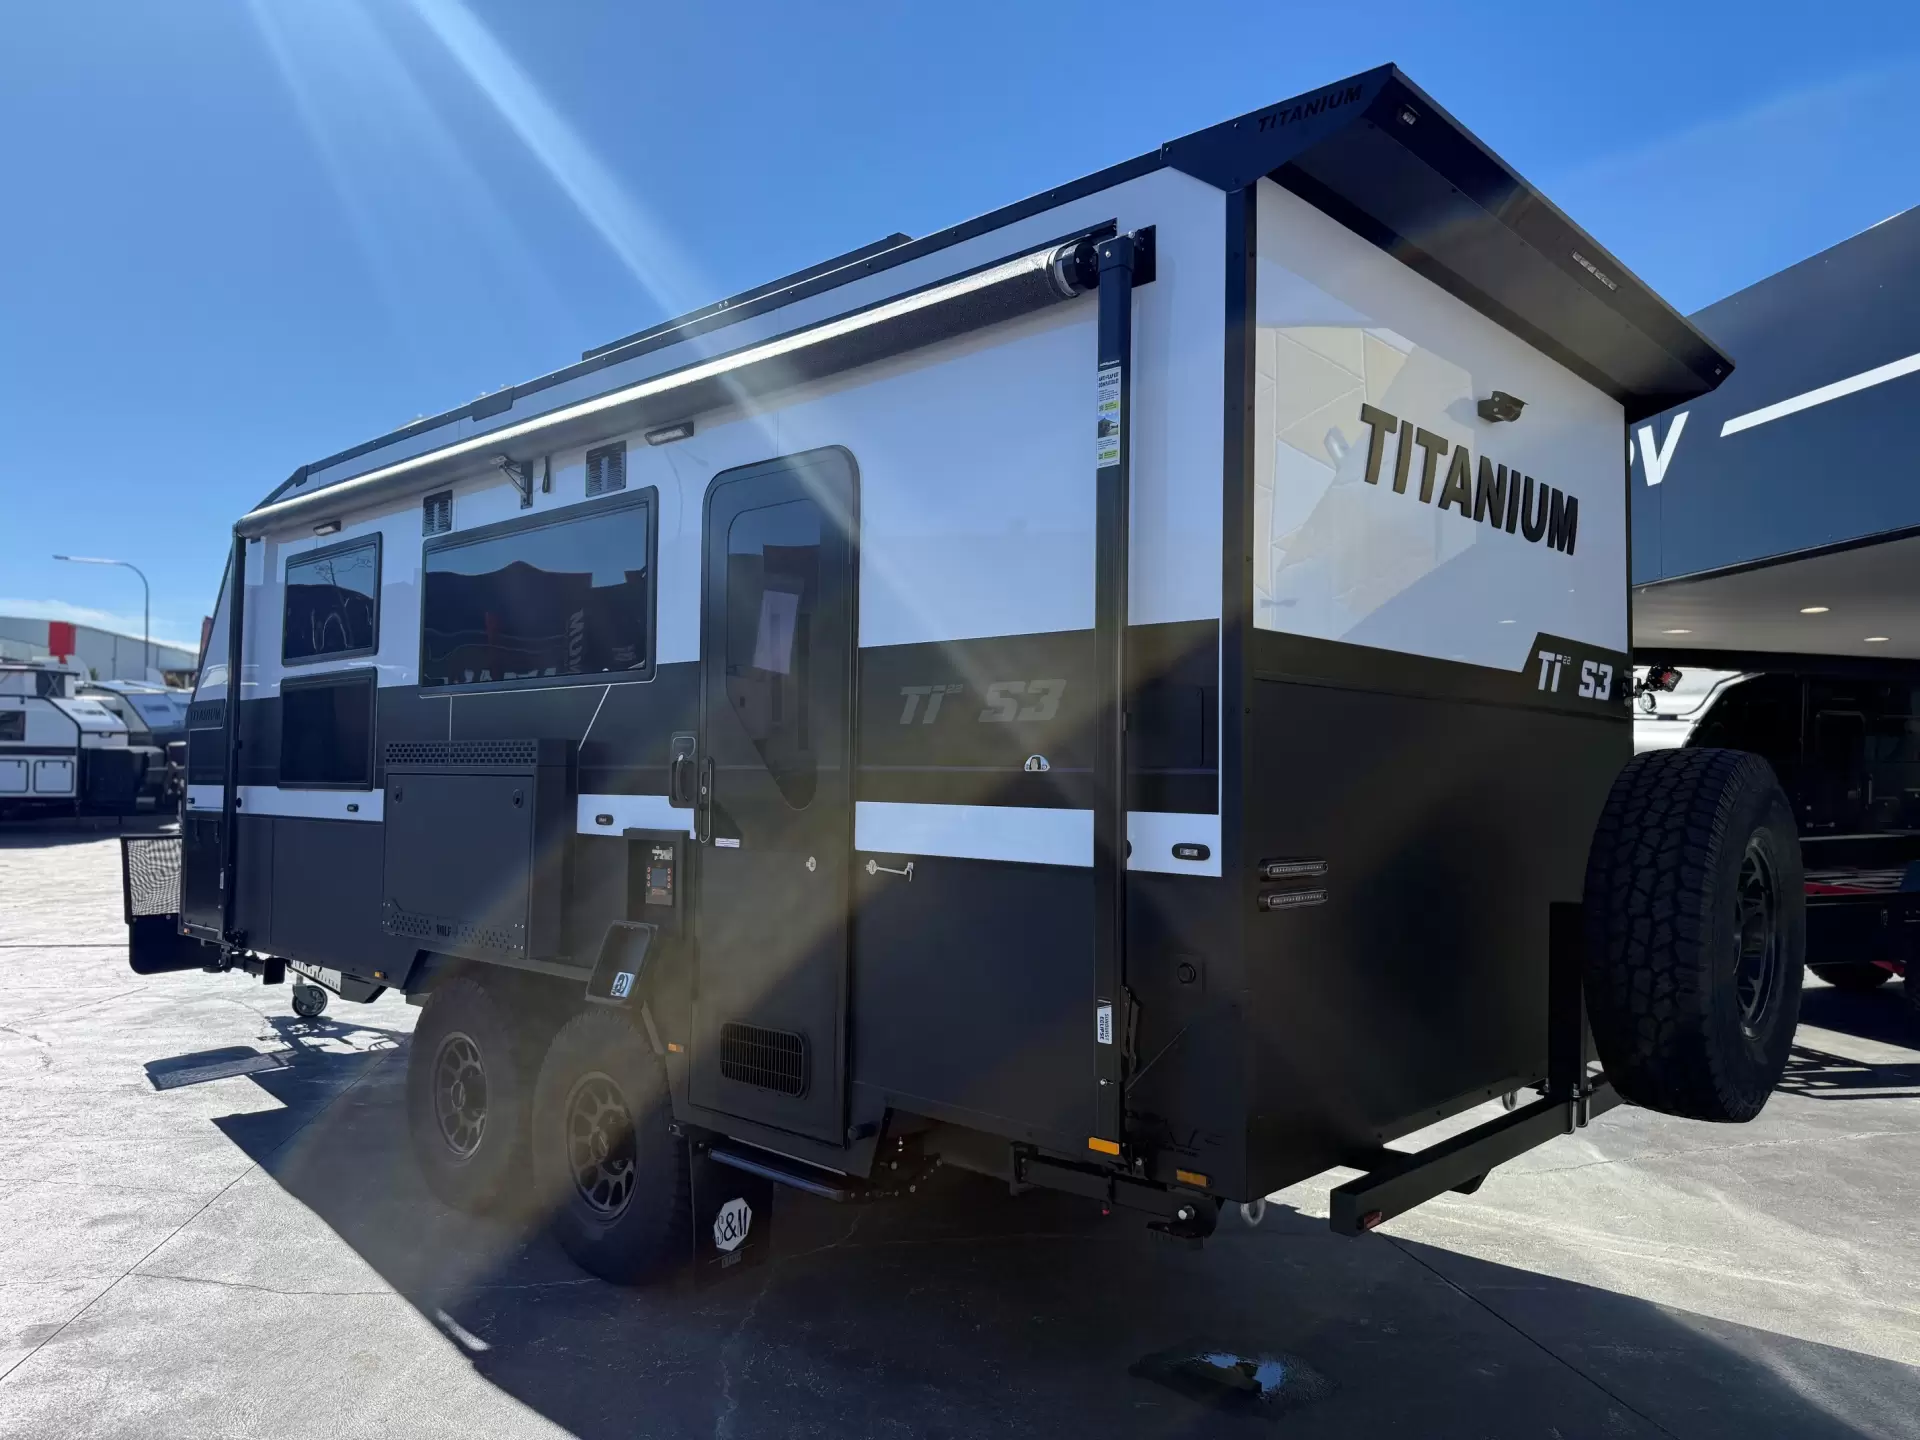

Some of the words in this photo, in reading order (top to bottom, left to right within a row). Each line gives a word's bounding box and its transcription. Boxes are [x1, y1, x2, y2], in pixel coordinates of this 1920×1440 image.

[1258, 83, 1363, 132] TITANIUM
[1630, 410, 1690, 487] V
[1360, 402, 1579, 556] TITANIUM
[978, 678, 1067, 723] S3
[1578, 659, 1613, 701] S3
